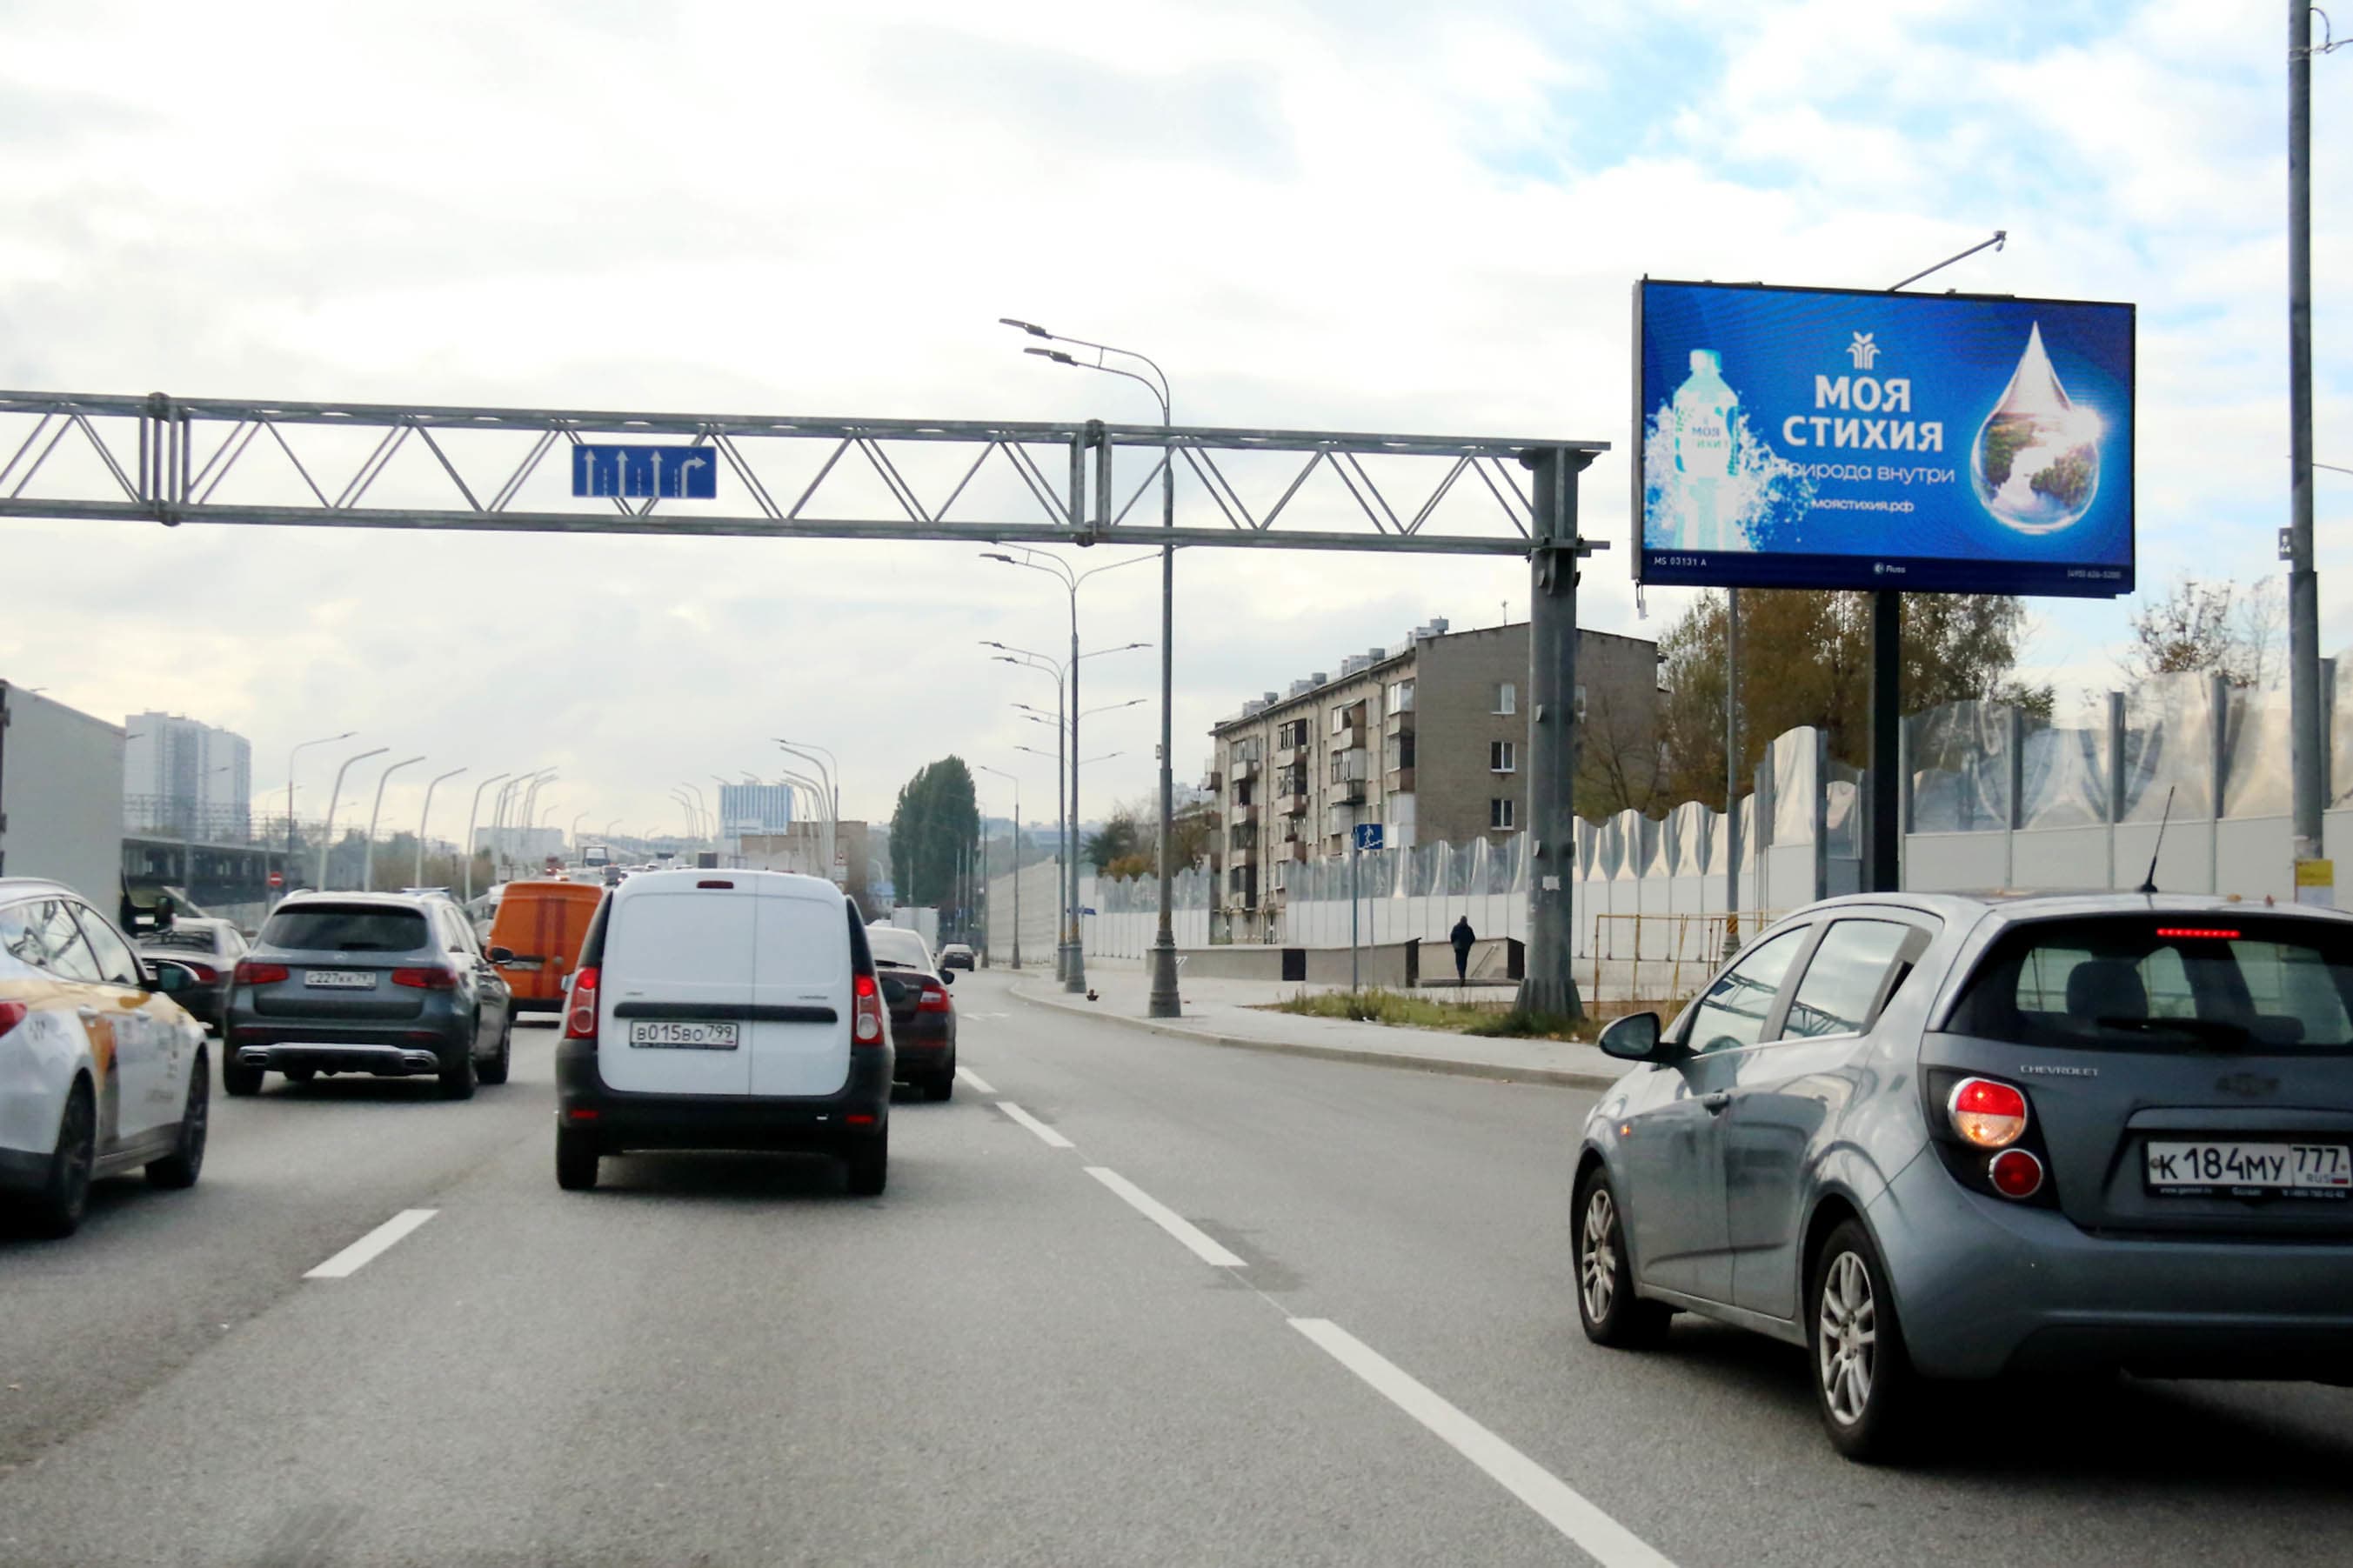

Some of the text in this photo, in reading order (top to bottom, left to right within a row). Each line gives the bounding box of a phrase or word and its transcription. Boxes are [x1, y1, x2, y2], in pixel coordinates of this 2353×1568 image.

[1815, 375, 1910, 413] МОЯ
[1782, 416, 1943, 452] СТИХИЯ
[1777, 463, 1955, 485] рирода внутри
[1811, 498, 1914, 513] моястихия.рф
[1654, 557, 1667, 565] MS
[1701, 558, 1708, 567] A
[706, 1024, 733, 1038] 799
[2019, 1064, 2099, 1078] CHEVROLET
[2159, 1146, 2340, 1182] К184МУ 777
